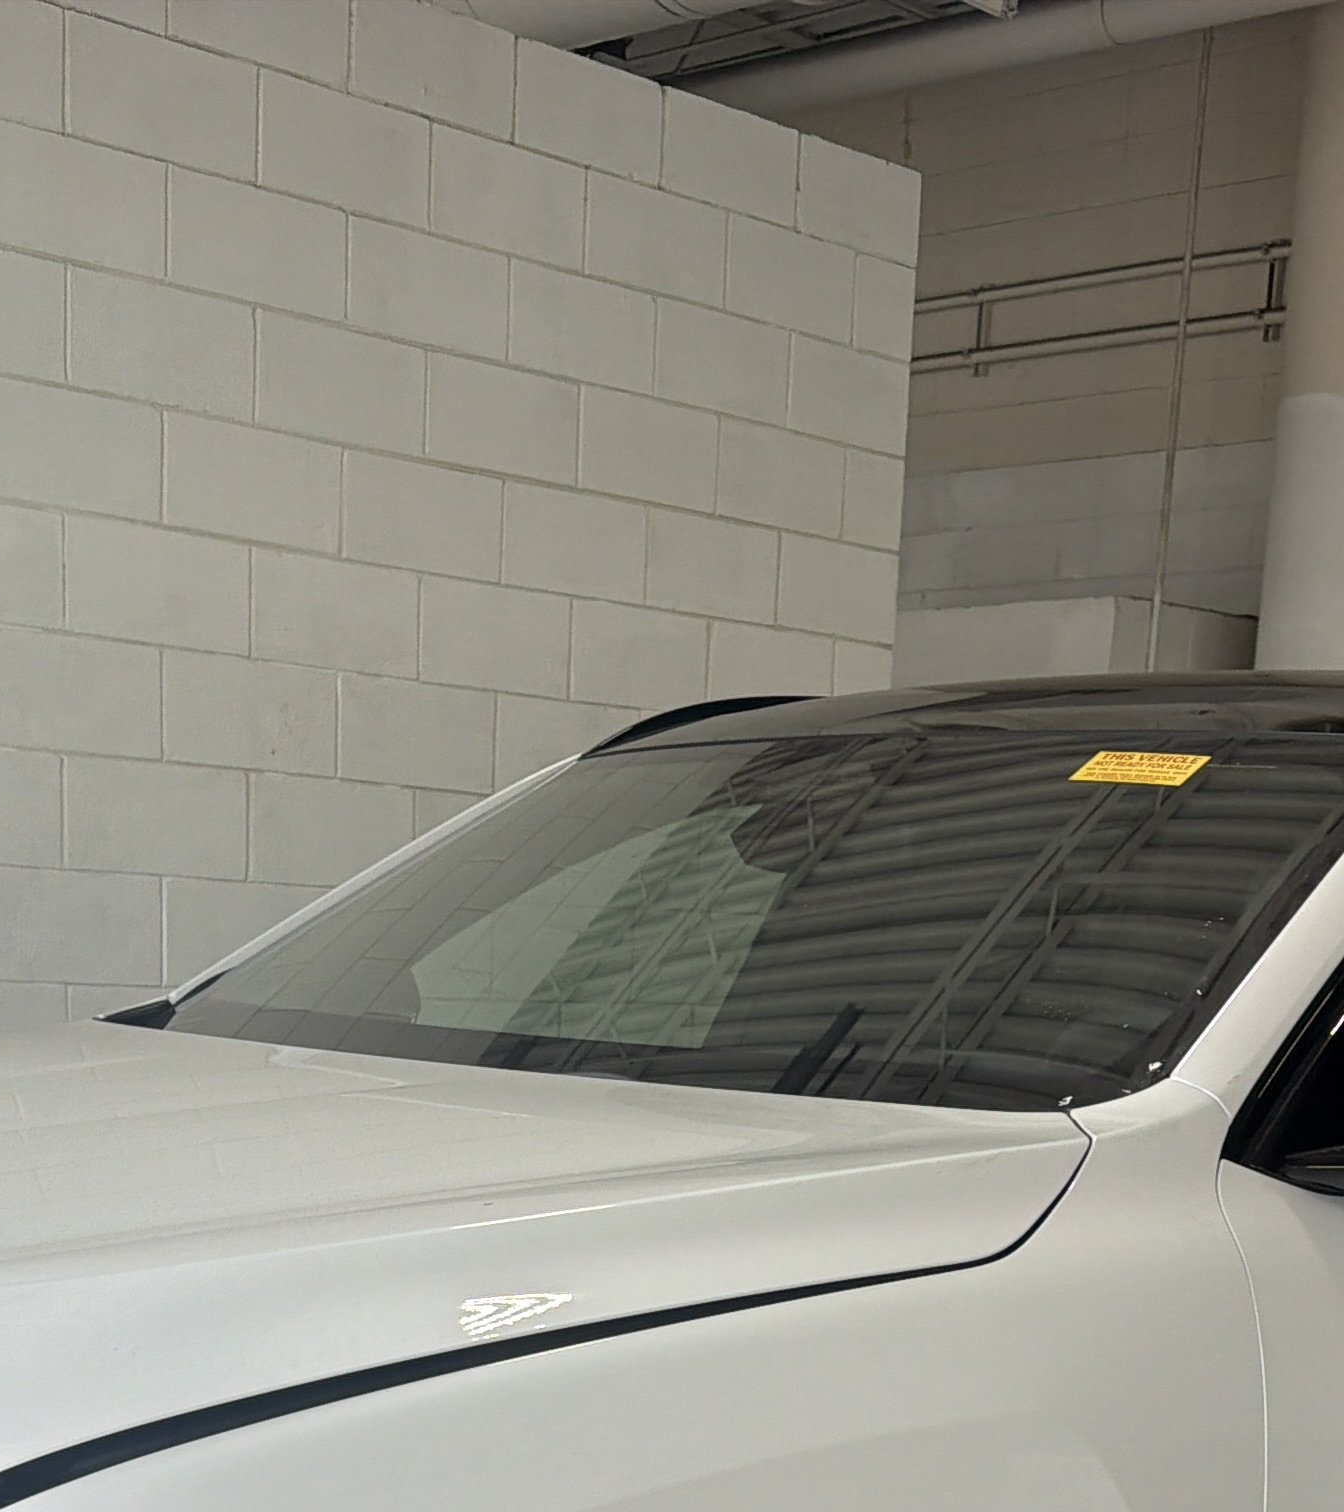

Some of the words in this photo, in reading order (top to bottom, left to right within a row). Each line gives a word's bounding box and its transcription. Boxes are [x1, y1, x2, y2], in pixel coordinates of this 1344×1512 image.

[1102, 753, 1135, 761] THIS
[1139, 754, 1202, 765] VEHICLE
[1166, 763, 1193, 771] SALE
